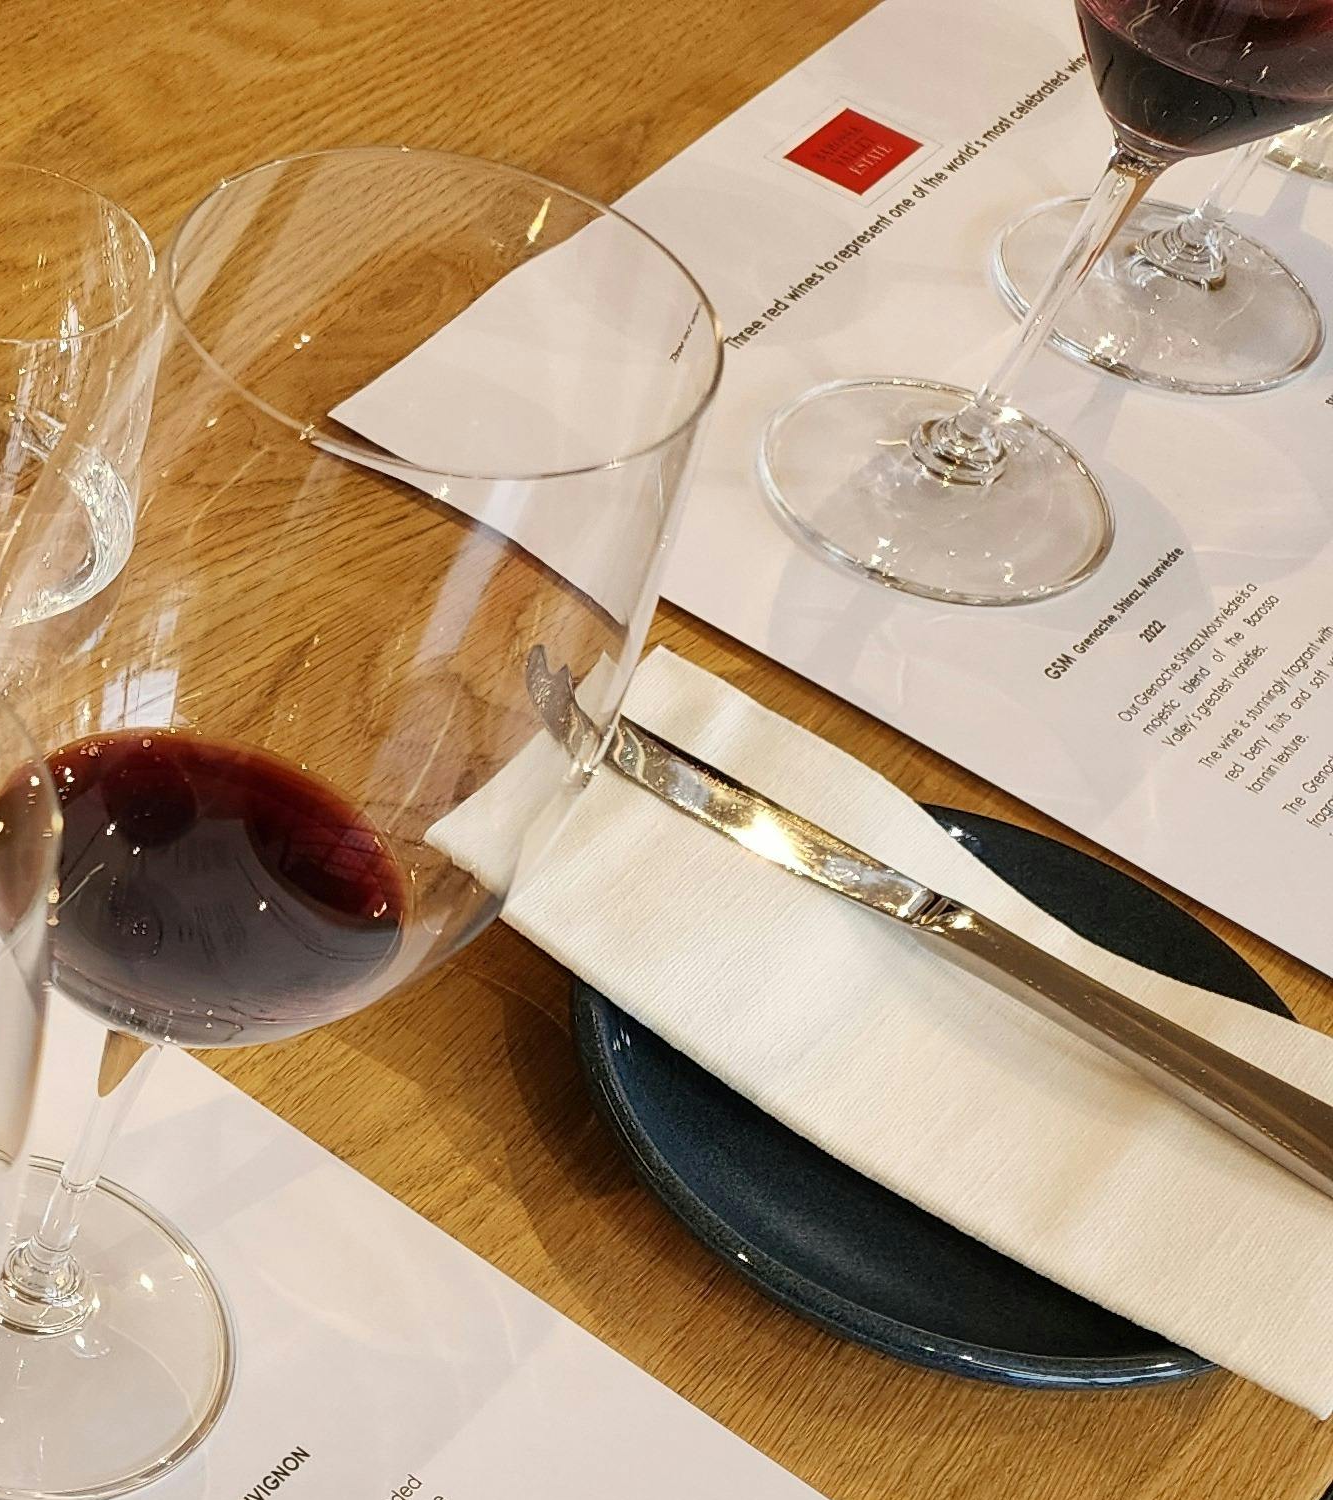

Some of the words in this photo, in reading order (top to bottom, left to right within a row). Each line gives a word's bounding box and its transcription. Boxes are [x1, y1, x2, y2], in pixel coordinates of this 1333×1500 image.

[1009, 70, 1071, 120] celebrated
[980, 115, 1015, 143] most
[941, 139, 988, 173] world's
[910, 183, 930, 199] of
[919, 170, 949, 189] the
[887, 197, 916, 218] one
[832, 213, 894, 264] represent
[814, 259, 839, 274] to
[782, 271, 825, 302] wines
[760, 297, 790, 322] red
[723, 319, 767, 350] Three
[1043, 652, 1077, 680] GSM
[1071, 612, 1122, 654] Grenache,
[1111, 587, 1146, 615] Shiraz,
[1136, 546, 1185, 591] Mourvèdre
[1137, 618, 1167, 644] 2022
